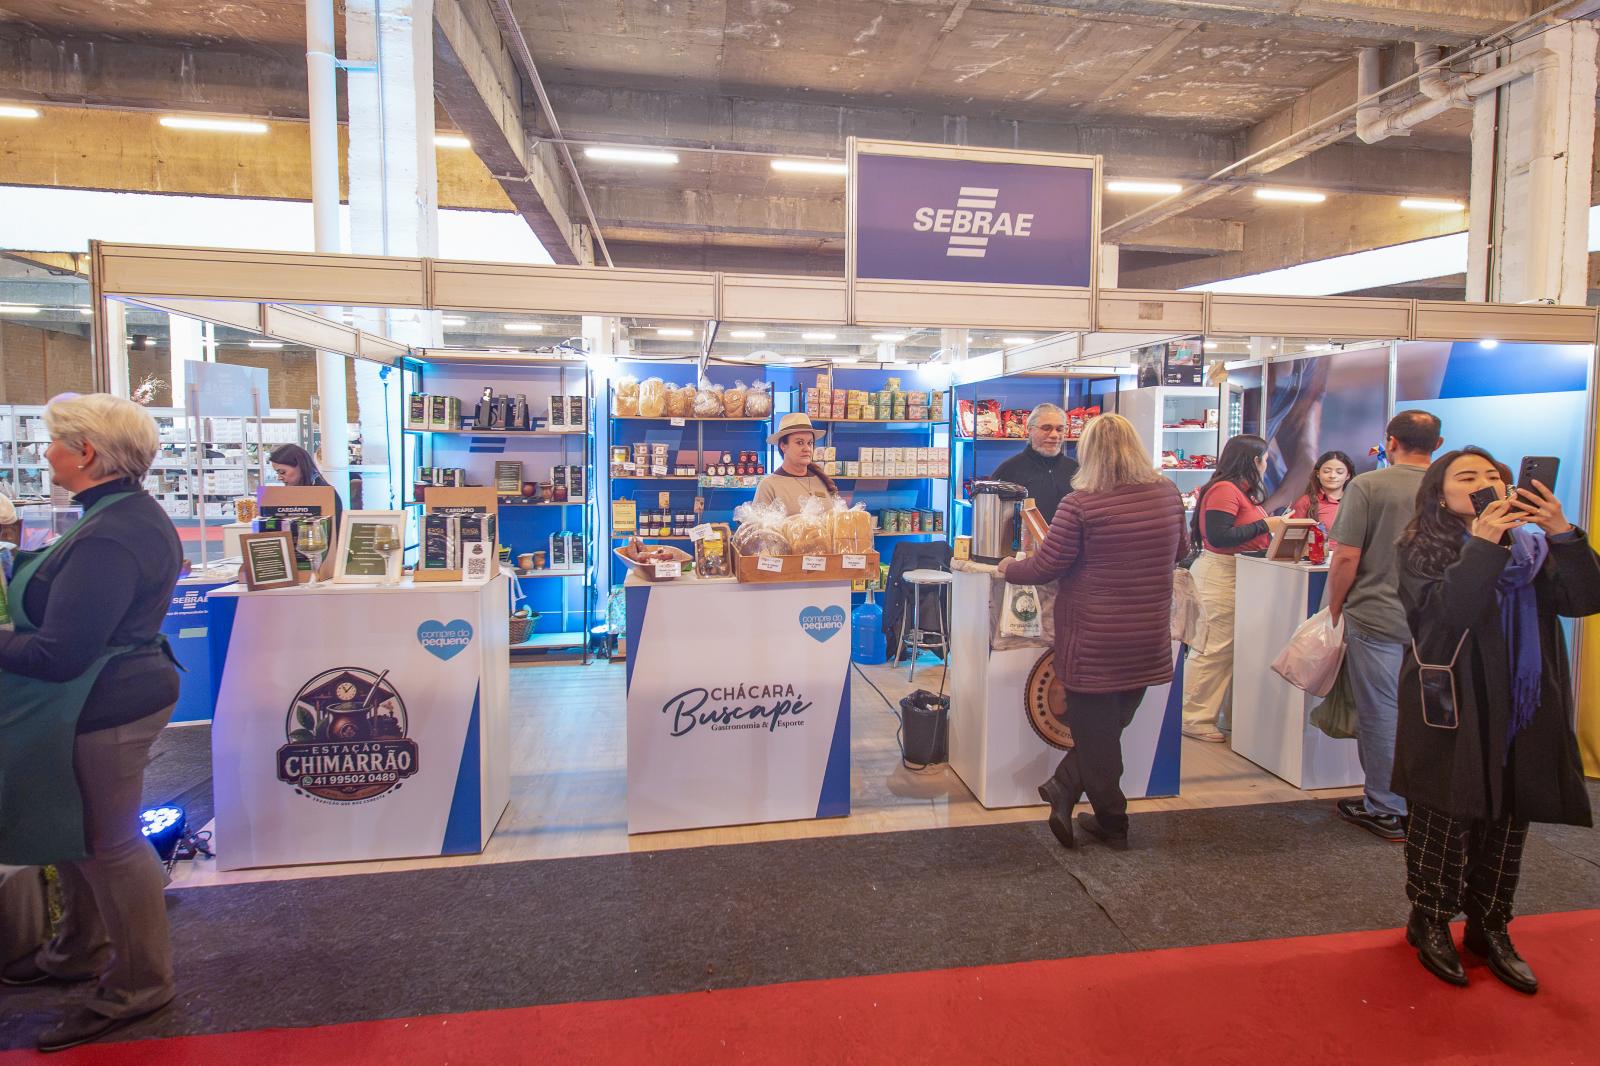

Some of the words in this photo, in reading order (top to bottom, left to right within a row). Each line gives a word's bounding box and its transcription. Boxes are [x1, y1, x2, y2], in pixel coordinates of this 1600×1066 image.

[912, 206, 1034, 237] SEBRAE
[802, 615, 832, 624] compre
[832, 614, 843, 622] do
[802, 621, 843, 631] pequeno
[421, 630, 456, 639] compre
[457, 628, 470, 637] do
[421, 637, 470, 648] pequeno
[710, 683, 795, 701] CHÁCARA
[662, 687, 813, 737] Buscapé
[710, 721, 761, 731] Gastronomia
[761, 721, 769, 729] &
[777, 719, 805, 730] Esporte
[312, 742, 381, 755] ESTAÇÃO
[284, 749, 411, 777] CHIMARRÃO
[314, 775, 327, 785] 41
[330, 774, 366, 784] 99502
[368, 773, 396, 783] 0489
